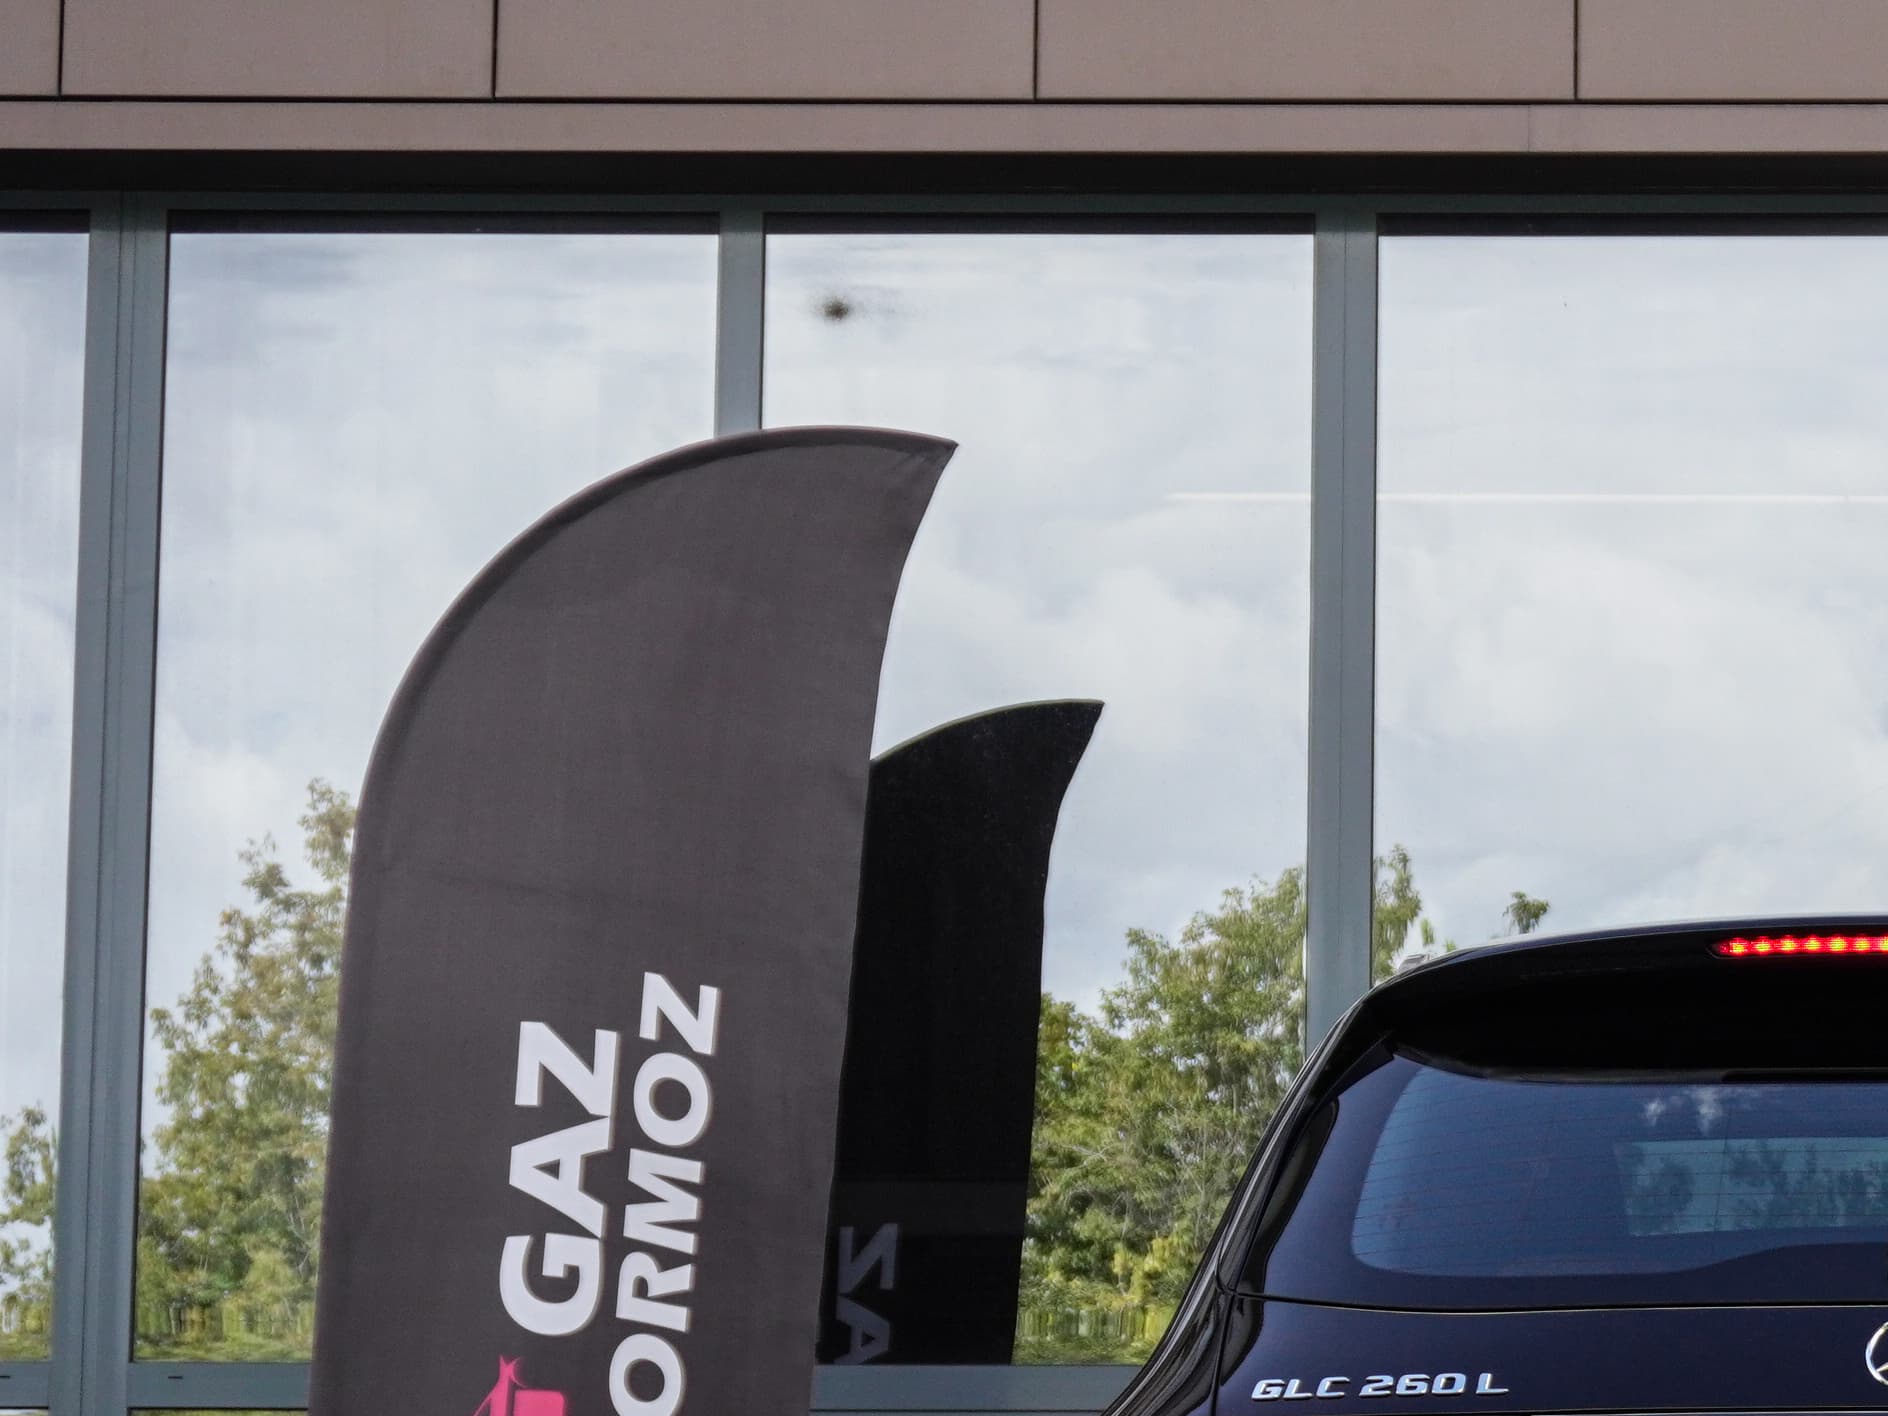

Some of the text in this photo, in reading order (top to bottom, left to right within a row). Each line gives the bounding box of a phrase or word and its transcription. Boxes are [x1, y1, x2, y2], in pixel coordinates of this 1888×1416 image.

[499, 1020, 619, 1336] GAZ
[1250, 1372, 1510, 1400] GLC 260 L
